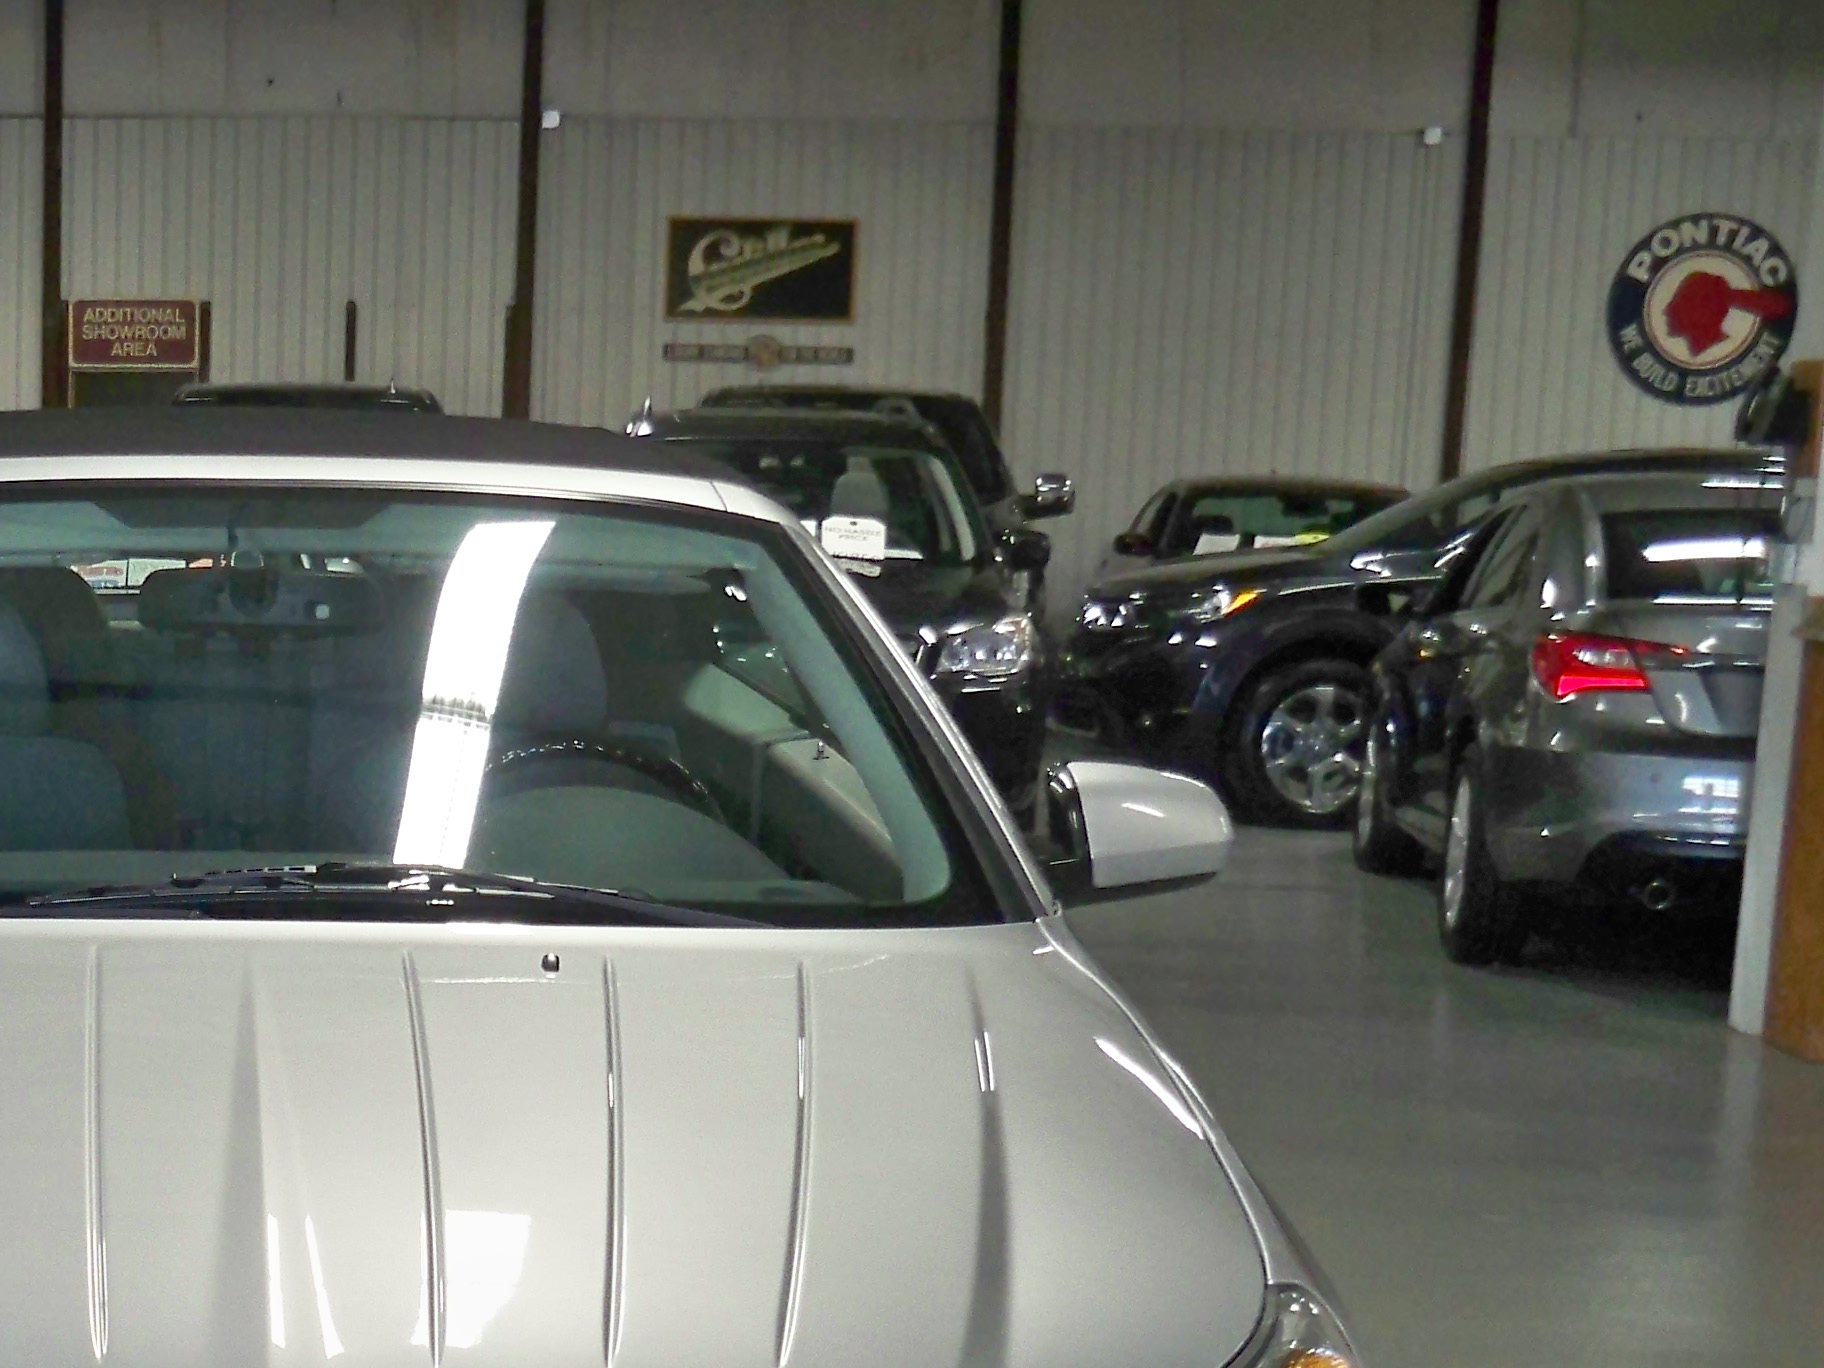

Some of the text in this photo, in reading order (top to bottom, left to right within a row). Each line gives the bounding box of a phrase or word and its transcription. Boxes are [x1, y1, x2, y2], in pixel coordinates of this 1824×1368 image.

[1627, 218, 1788, 288] PONTIAC
[82, 307, 185, 323] ADDITIONAL
[81, 324, 188, 340] SHOWROOM
[110, 341, 158, 357] AREA
